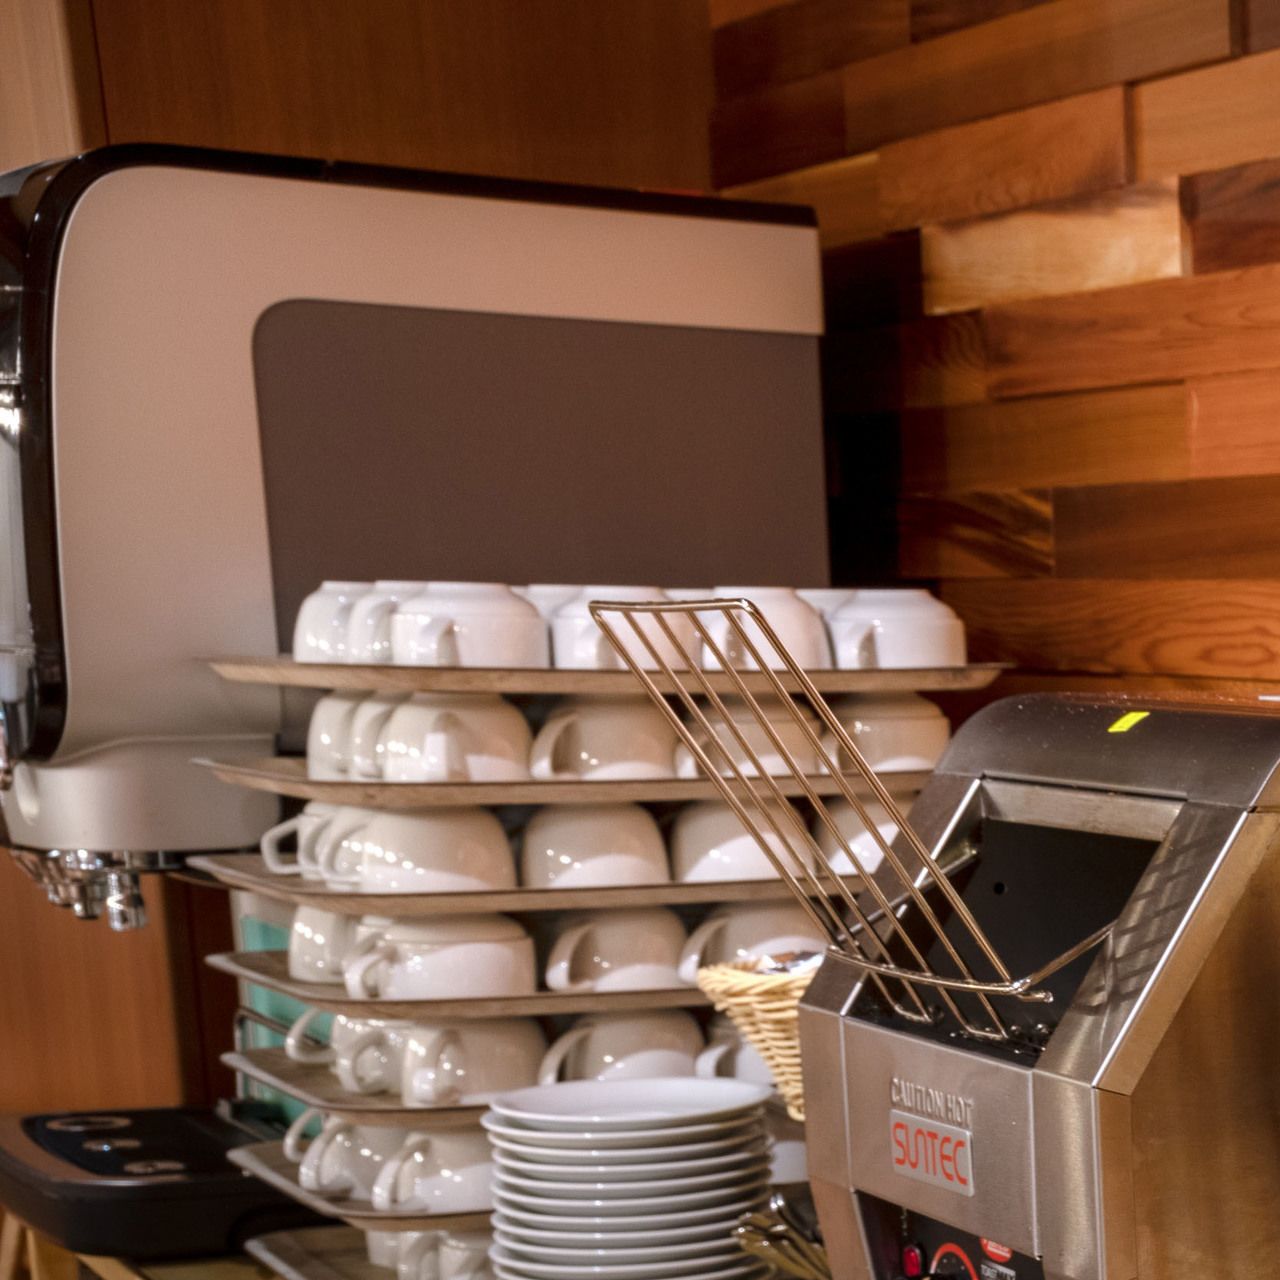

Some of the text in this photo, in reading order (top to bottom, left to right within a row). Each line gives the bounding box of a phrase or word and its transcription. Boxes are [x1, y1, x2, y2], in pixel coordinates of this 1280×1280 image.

[891, 1078, 973, 1129] CAUTION HOT
[892, 1121, 968, 1186] SUNTEC
